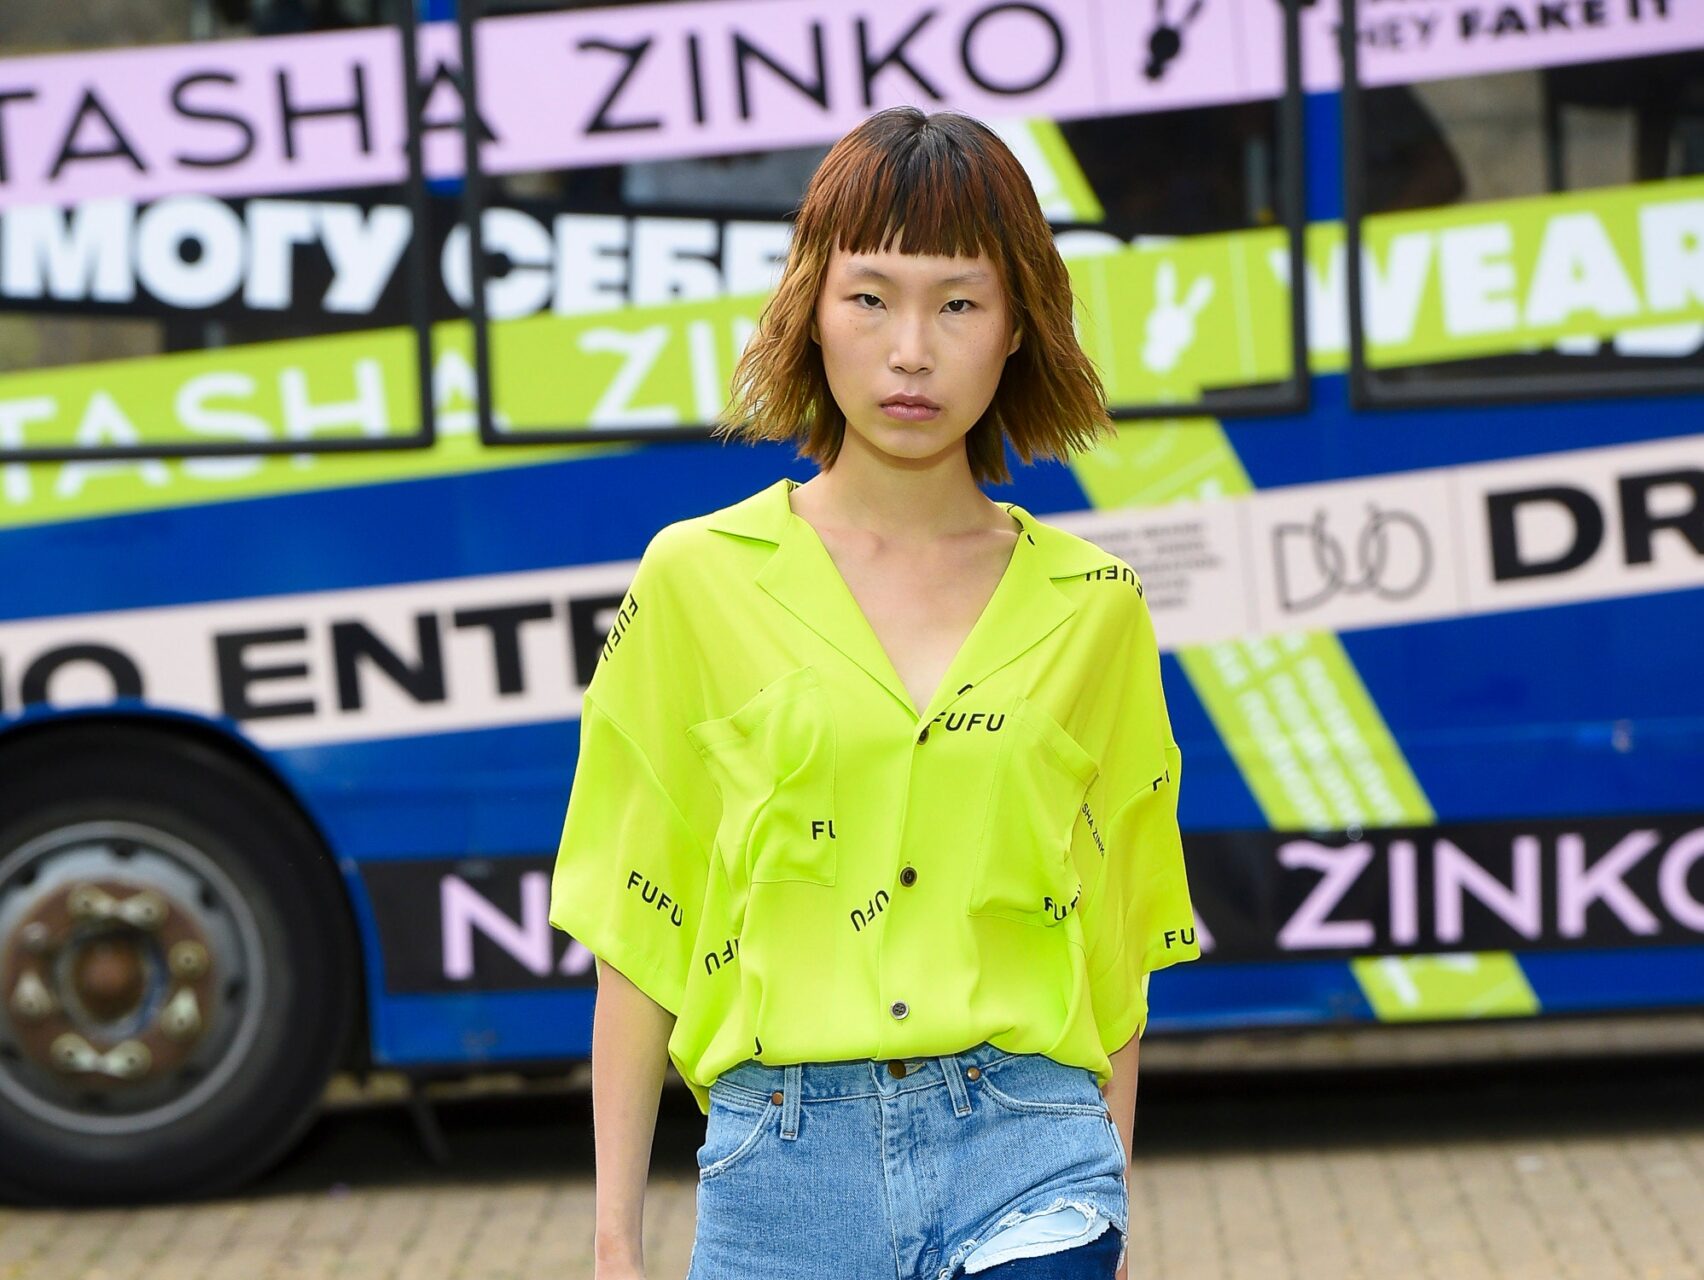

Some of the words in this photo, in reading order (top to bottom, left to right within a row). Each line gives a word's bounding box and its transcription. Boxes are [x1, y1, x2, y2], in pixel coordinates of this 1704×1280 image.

[1459, 2, 1607, 40] FAKE
[576, 5, 1065, 134] ZINKO
[2, 197, 413, 314] МОГУ
[627, 870, 683, 927] FUFU
[1164, 927, 1194, 949] FU
